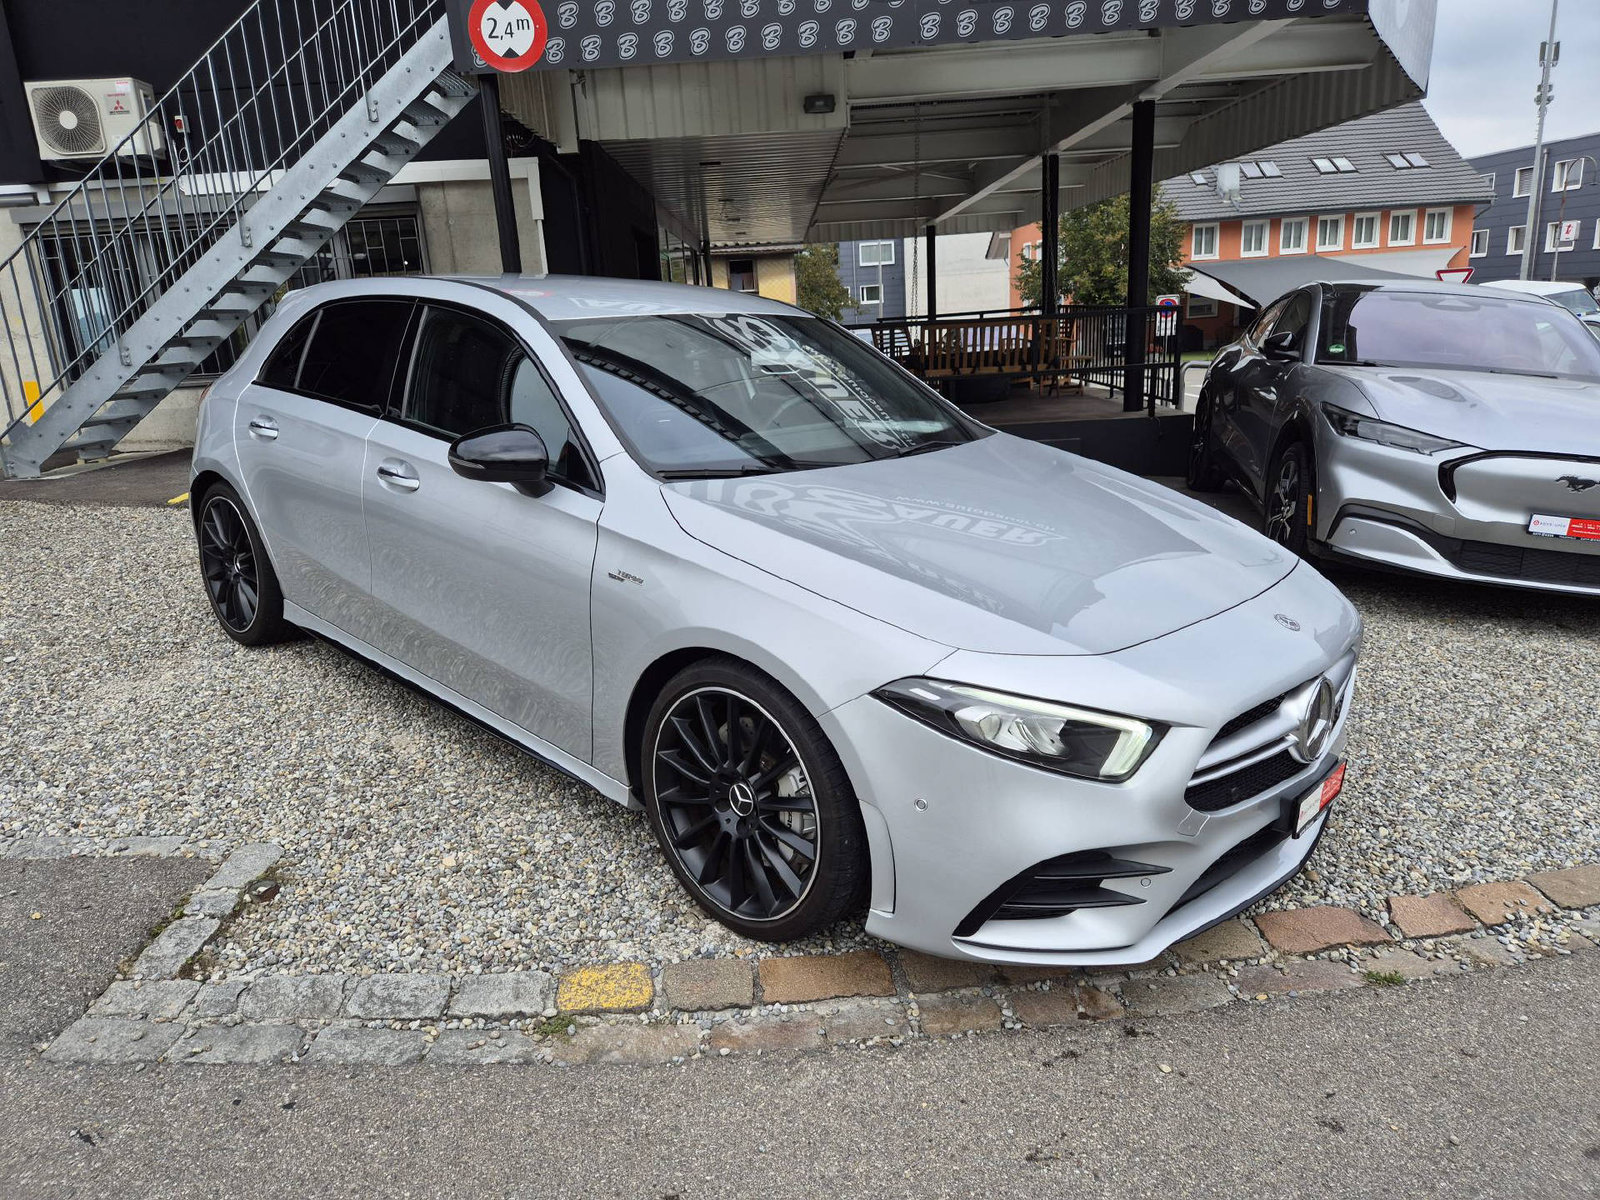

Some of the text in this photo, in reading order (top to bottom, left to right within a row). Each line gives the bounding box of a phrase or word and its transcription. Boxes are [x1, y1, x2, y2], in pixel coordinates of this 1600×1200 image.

[542, 37, 565, 63] B
[580, 35, 601, 61] B
[617, 32, 638, 60] B
[653, 30, 674, 57] B
[689, 28, 710, 55] B
[725, 25, 746, 53] B
[761, 23, 782, 50] B
[798, 20, 819, 48] B
[835, 18, 857, 45] B
[871, 16, 893, 42] B
[920, 12, 941, 40] B
[956, 9, 978, 37] B
[992, 6, 1014, 34] B
[1029, 3, 1050, 31] B
[1065, 0, 1087, 28] B
[1101, 0, 1123, 25] B
[557, 0, 579, 29] B
[594, 0, 615, 27] B
[630, 0, 652, 24] B
